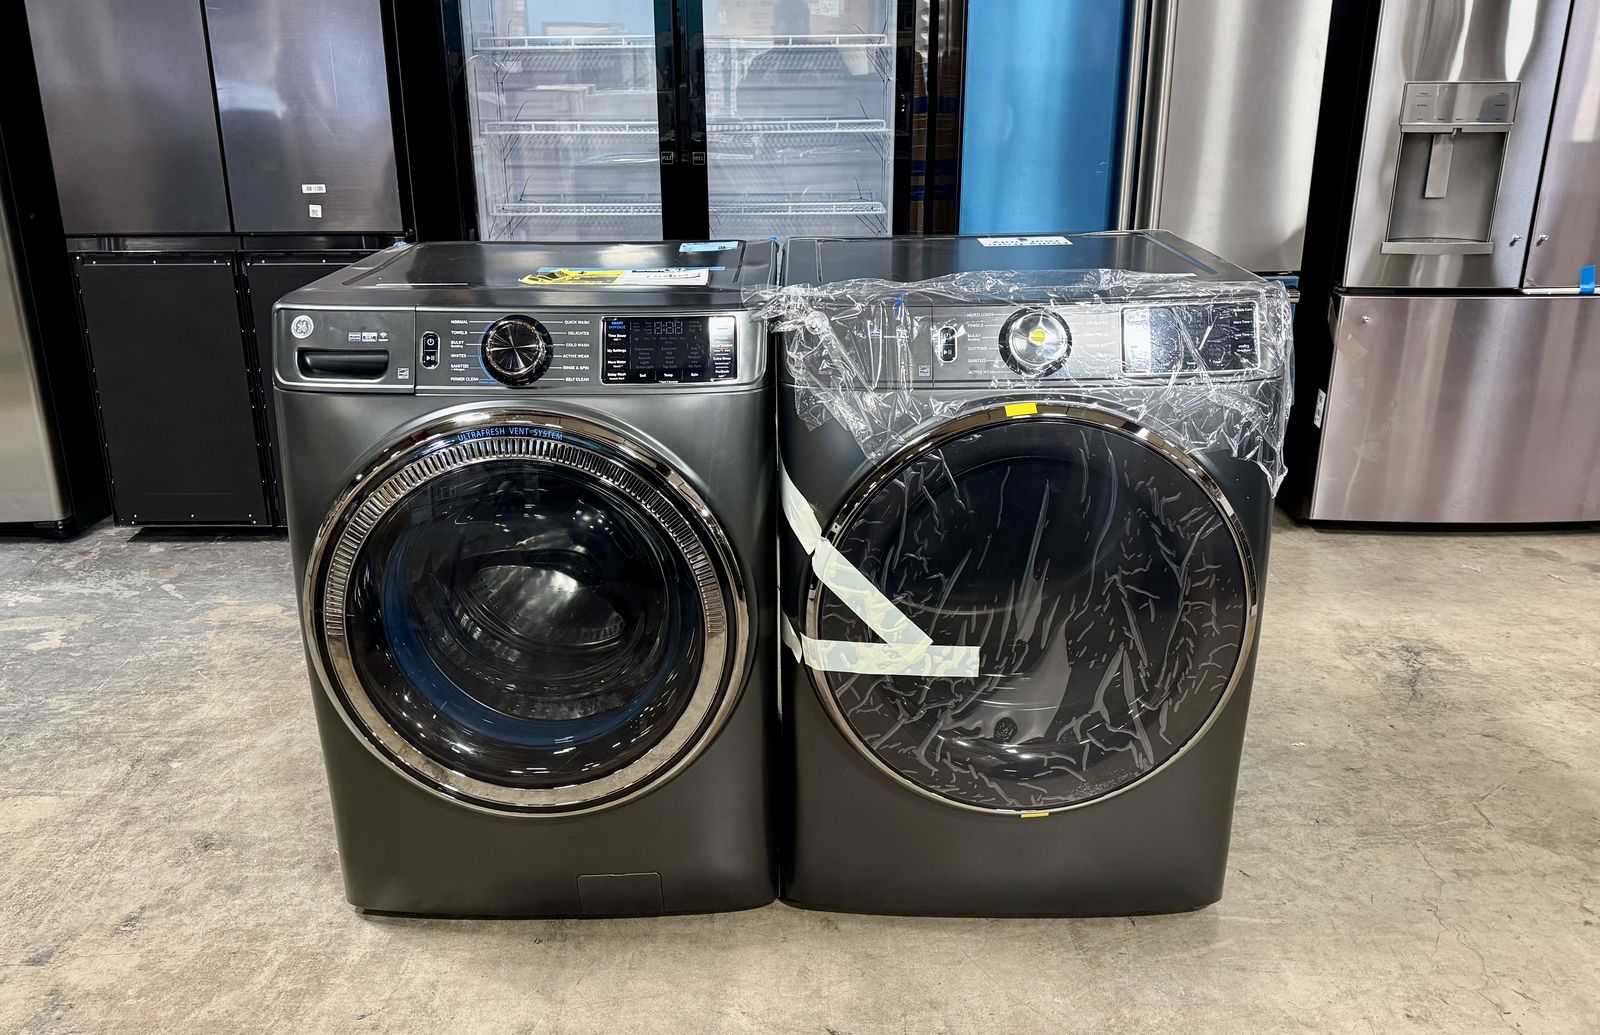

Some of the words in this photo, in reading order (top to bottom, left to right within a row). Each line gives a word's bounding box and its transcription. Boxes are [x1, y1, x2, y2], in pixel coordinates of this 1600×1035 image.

[457, 427, 505, 441] ULTRAFRESH
[508, 427, 529, 436] VENT
[533, 429, 563, 440] SYSTEM
